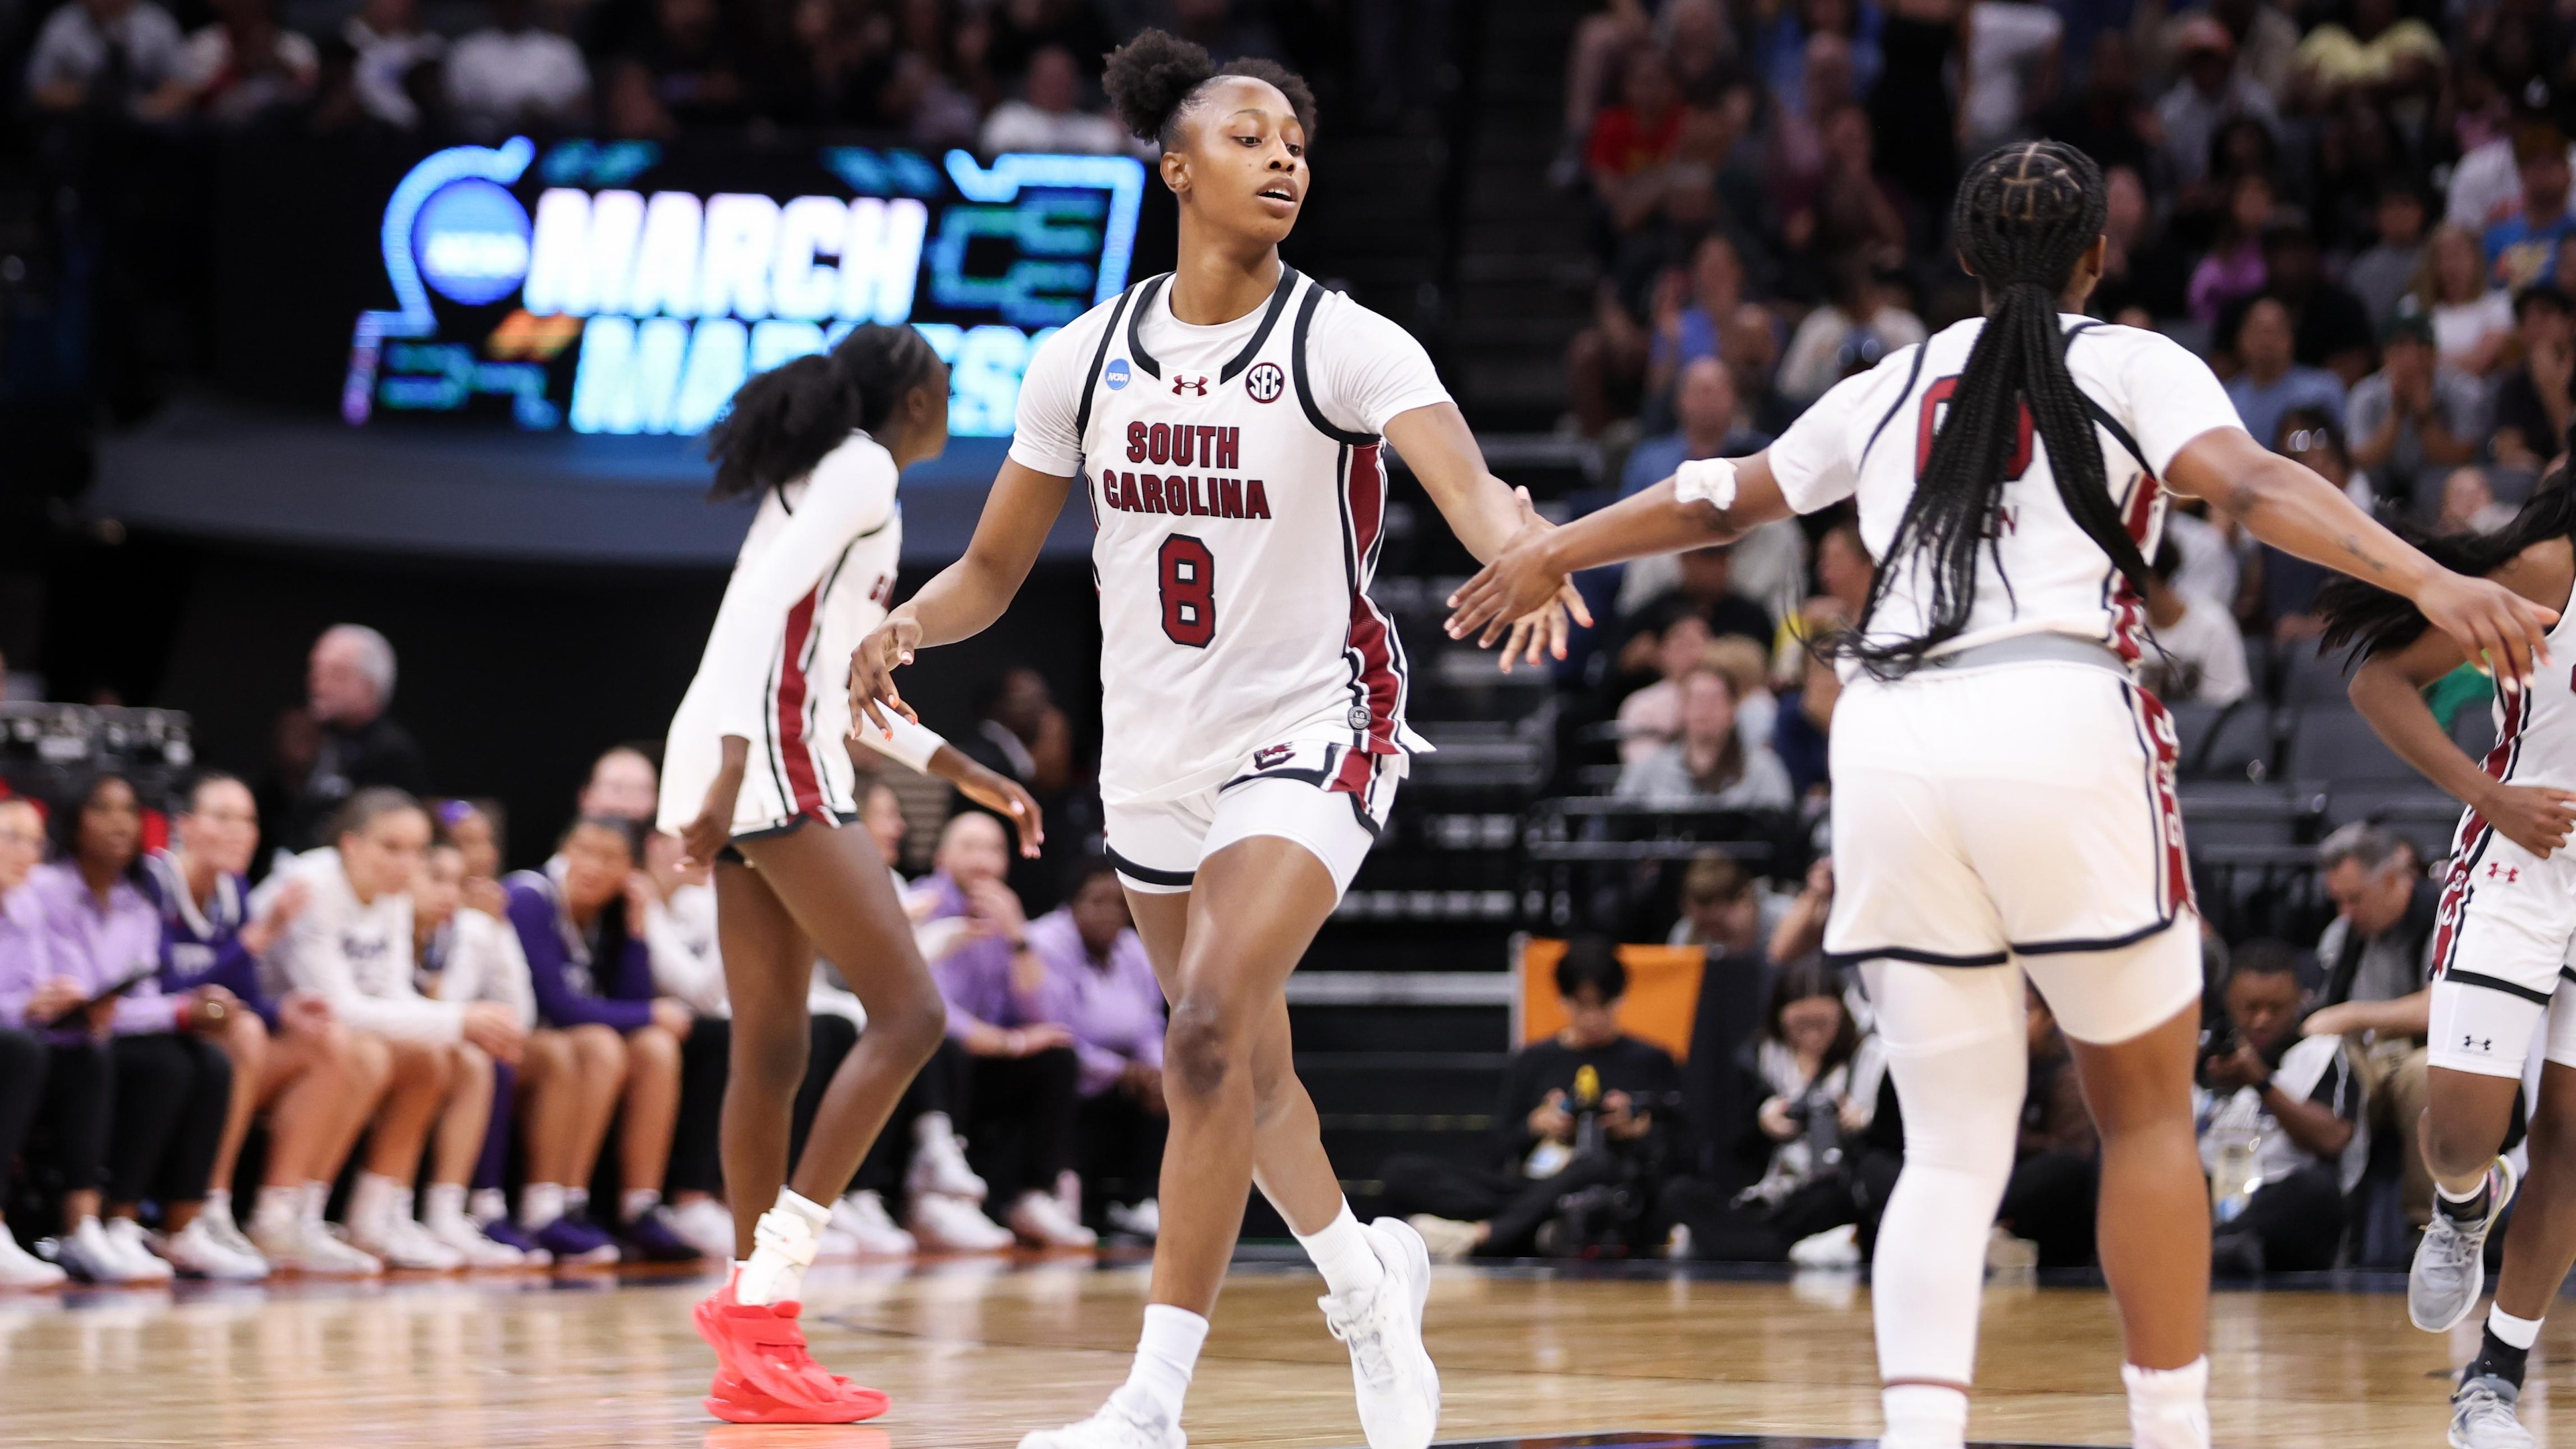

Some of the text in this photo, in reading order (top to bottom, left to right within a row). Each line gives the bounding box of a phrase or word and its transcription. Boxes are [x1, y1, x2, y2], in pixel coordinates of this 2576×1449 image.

[523, 187, 928, 324] MARCH
[1107, 372, 1130, 382] NCAA
[1248, 364, 1282, 401] SEC
[1126, 421, 1240, 470] SOUTH
[1103, 468, 1272, 519] CAROLINA
[1158, 533, 1216, 648] 8
